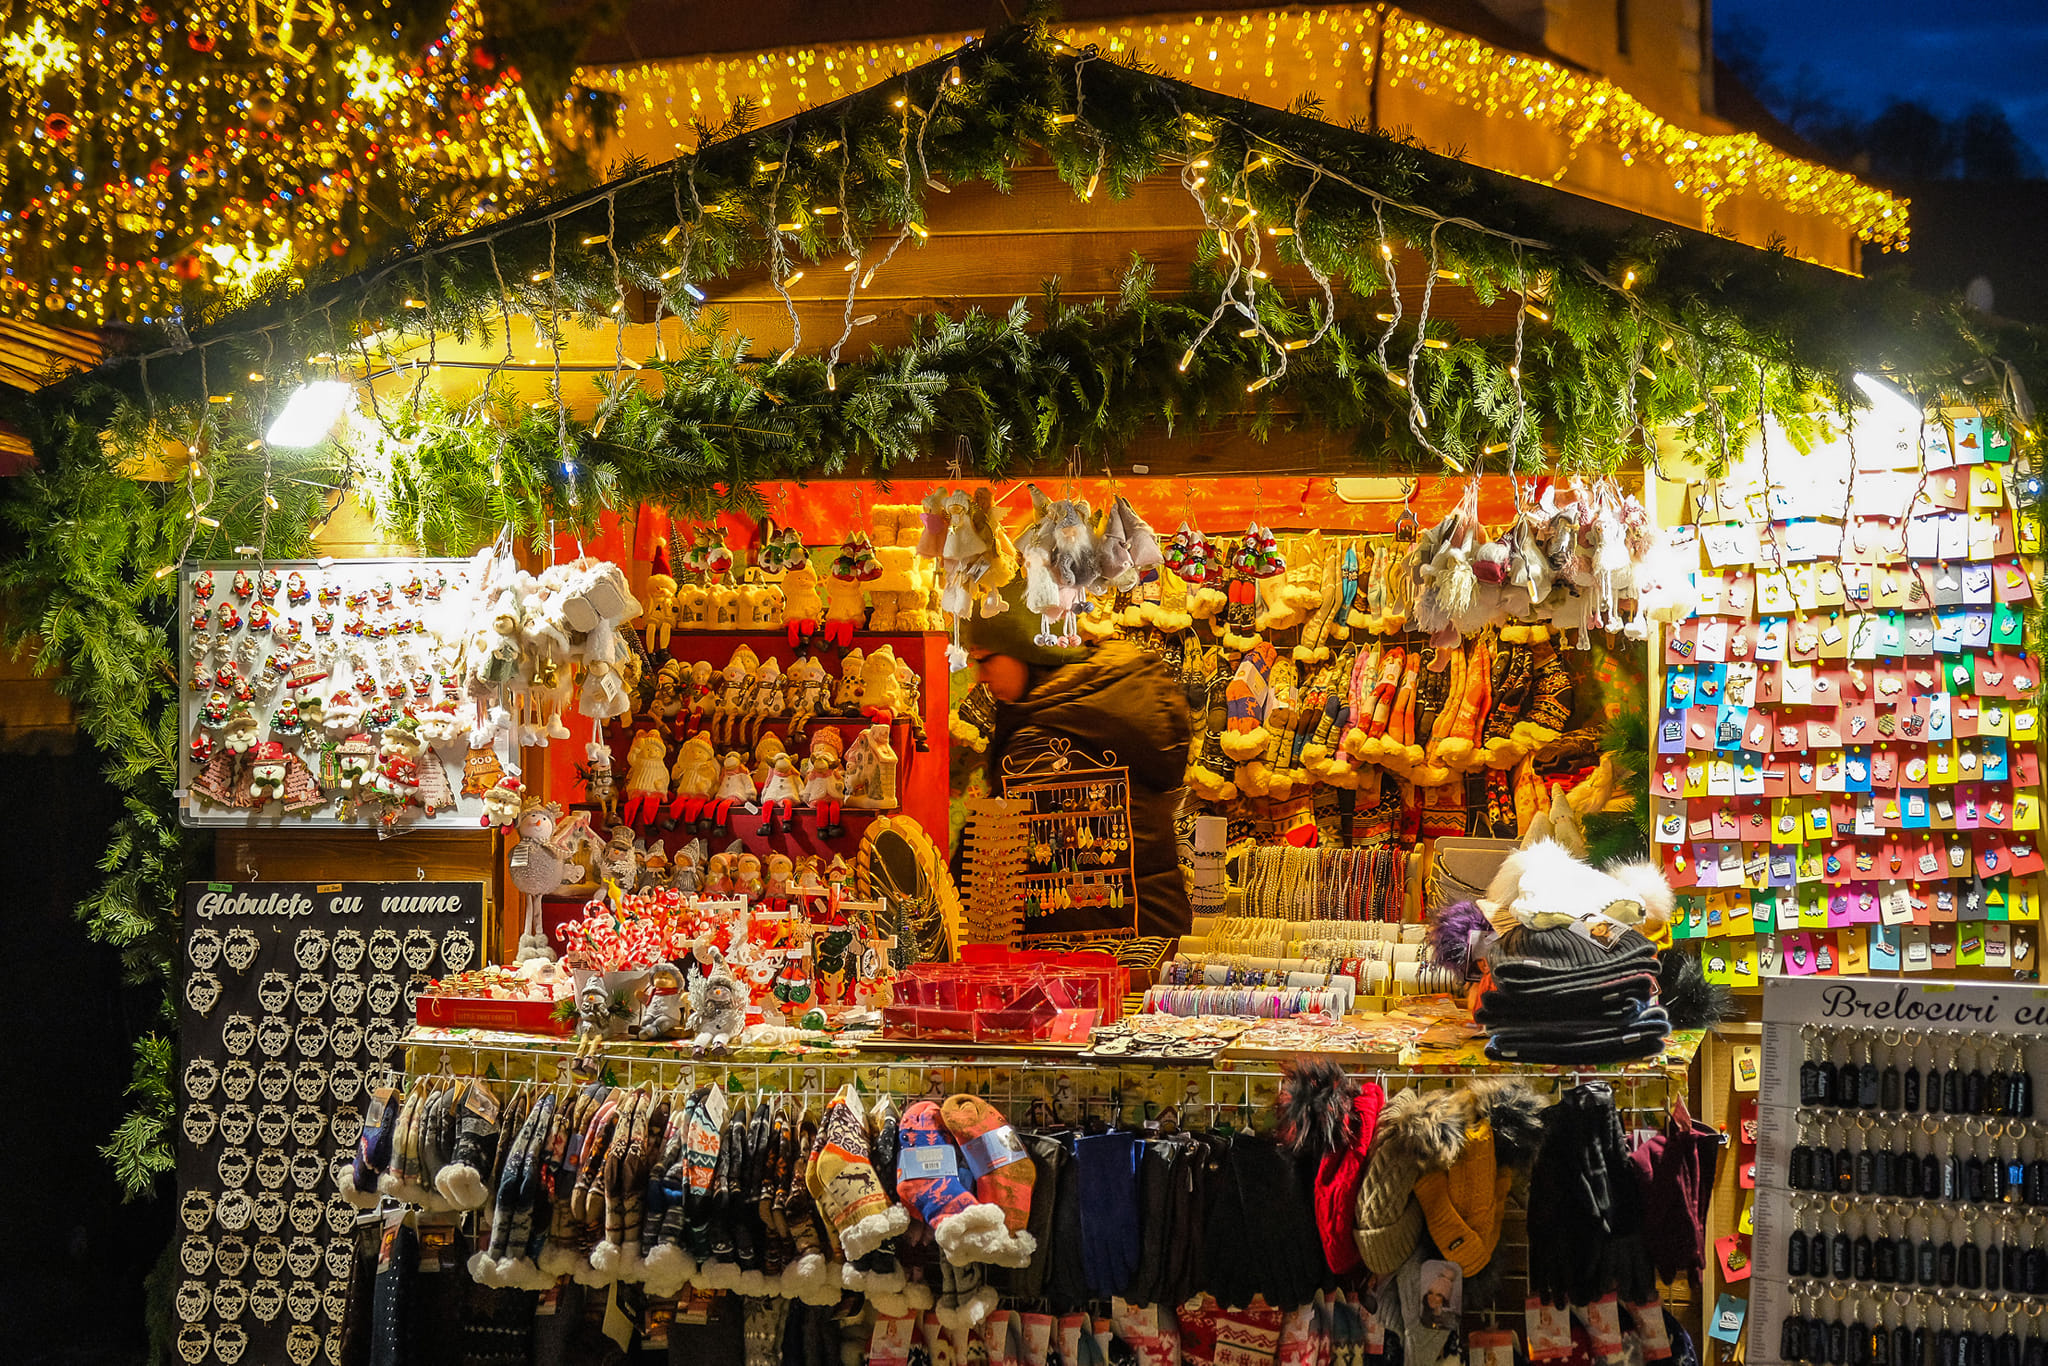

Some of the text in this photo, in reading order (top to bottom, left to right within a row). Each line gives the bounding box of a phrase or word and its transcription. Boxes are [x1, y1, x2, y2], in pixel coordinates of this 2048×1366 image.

[329, 896, 364, 914] cu
[381, 895, 463, 913] nume
[1822, 985, 1998, 1023] Brelocuri
[1818, 1070, 1828, 1098] Adam
[1944, 1164, 1953, 1197] Anda
